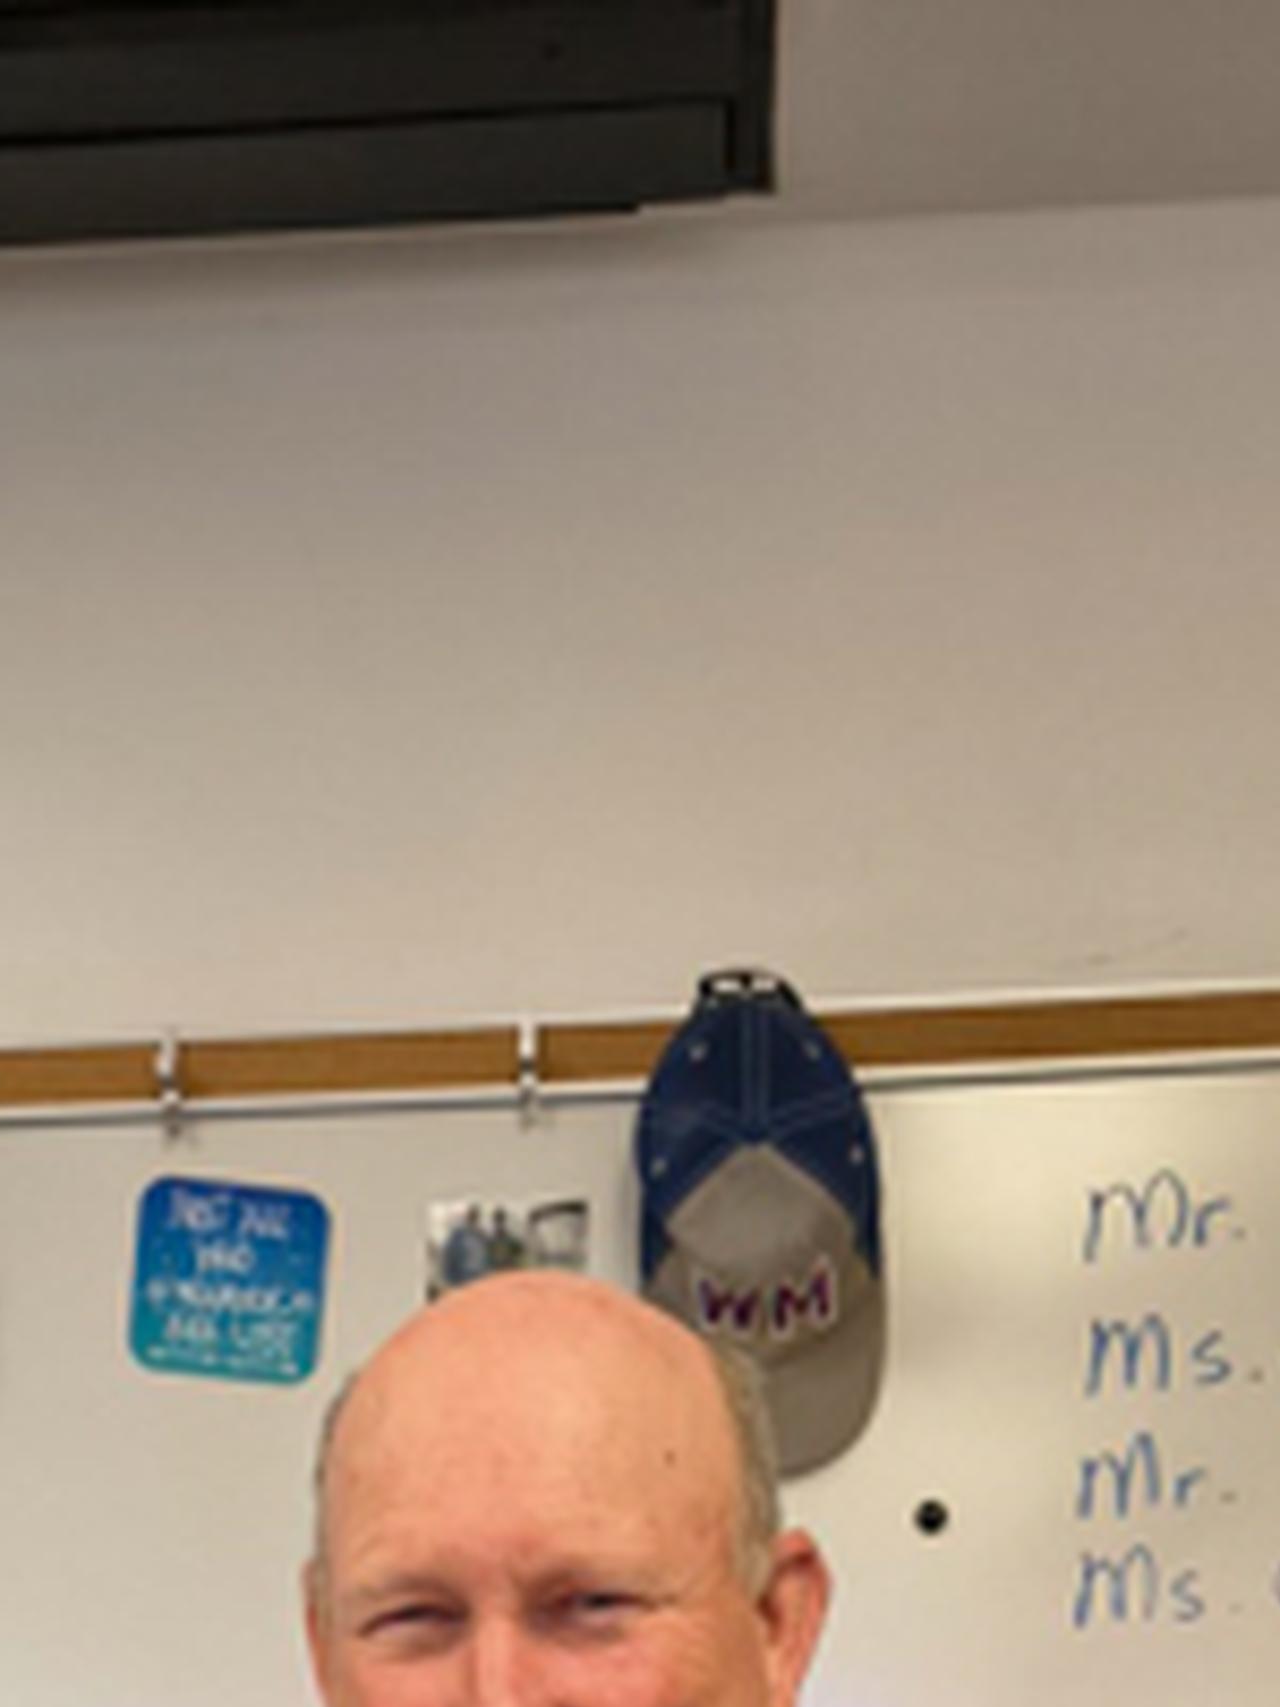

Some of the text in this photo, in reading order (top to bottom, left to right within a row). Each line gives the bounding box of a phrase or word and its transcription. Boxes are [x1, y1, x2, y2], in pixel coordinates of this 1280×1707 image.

[1083, 1168, 1246, 1262] Mr.
[1086, 1312, 1265, 1395] Ms.
[1077, 1432, 1237, 1519] Mr.
[1074, 1544, 1242, 1629] Ms.
